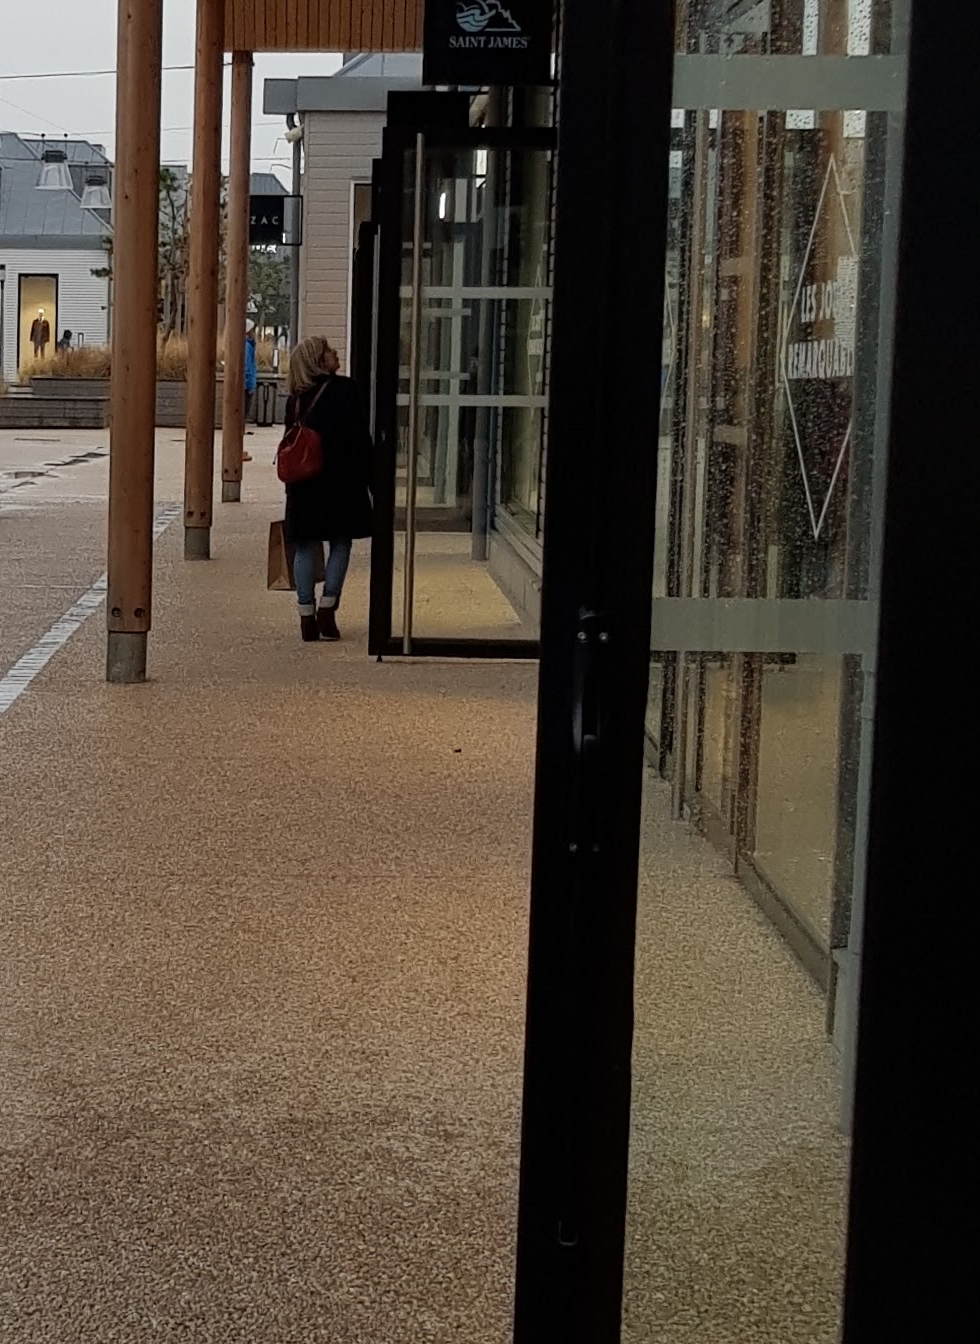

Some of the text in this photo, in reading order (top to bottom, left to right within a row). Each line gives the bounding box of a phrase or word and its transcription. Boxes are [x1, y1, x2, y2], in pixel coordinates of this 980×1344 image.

[449, 35, 529, 49] SAINT JAMES
[250, 215, 279, 225] ZAC
[801, 283, 817, 323] LES
